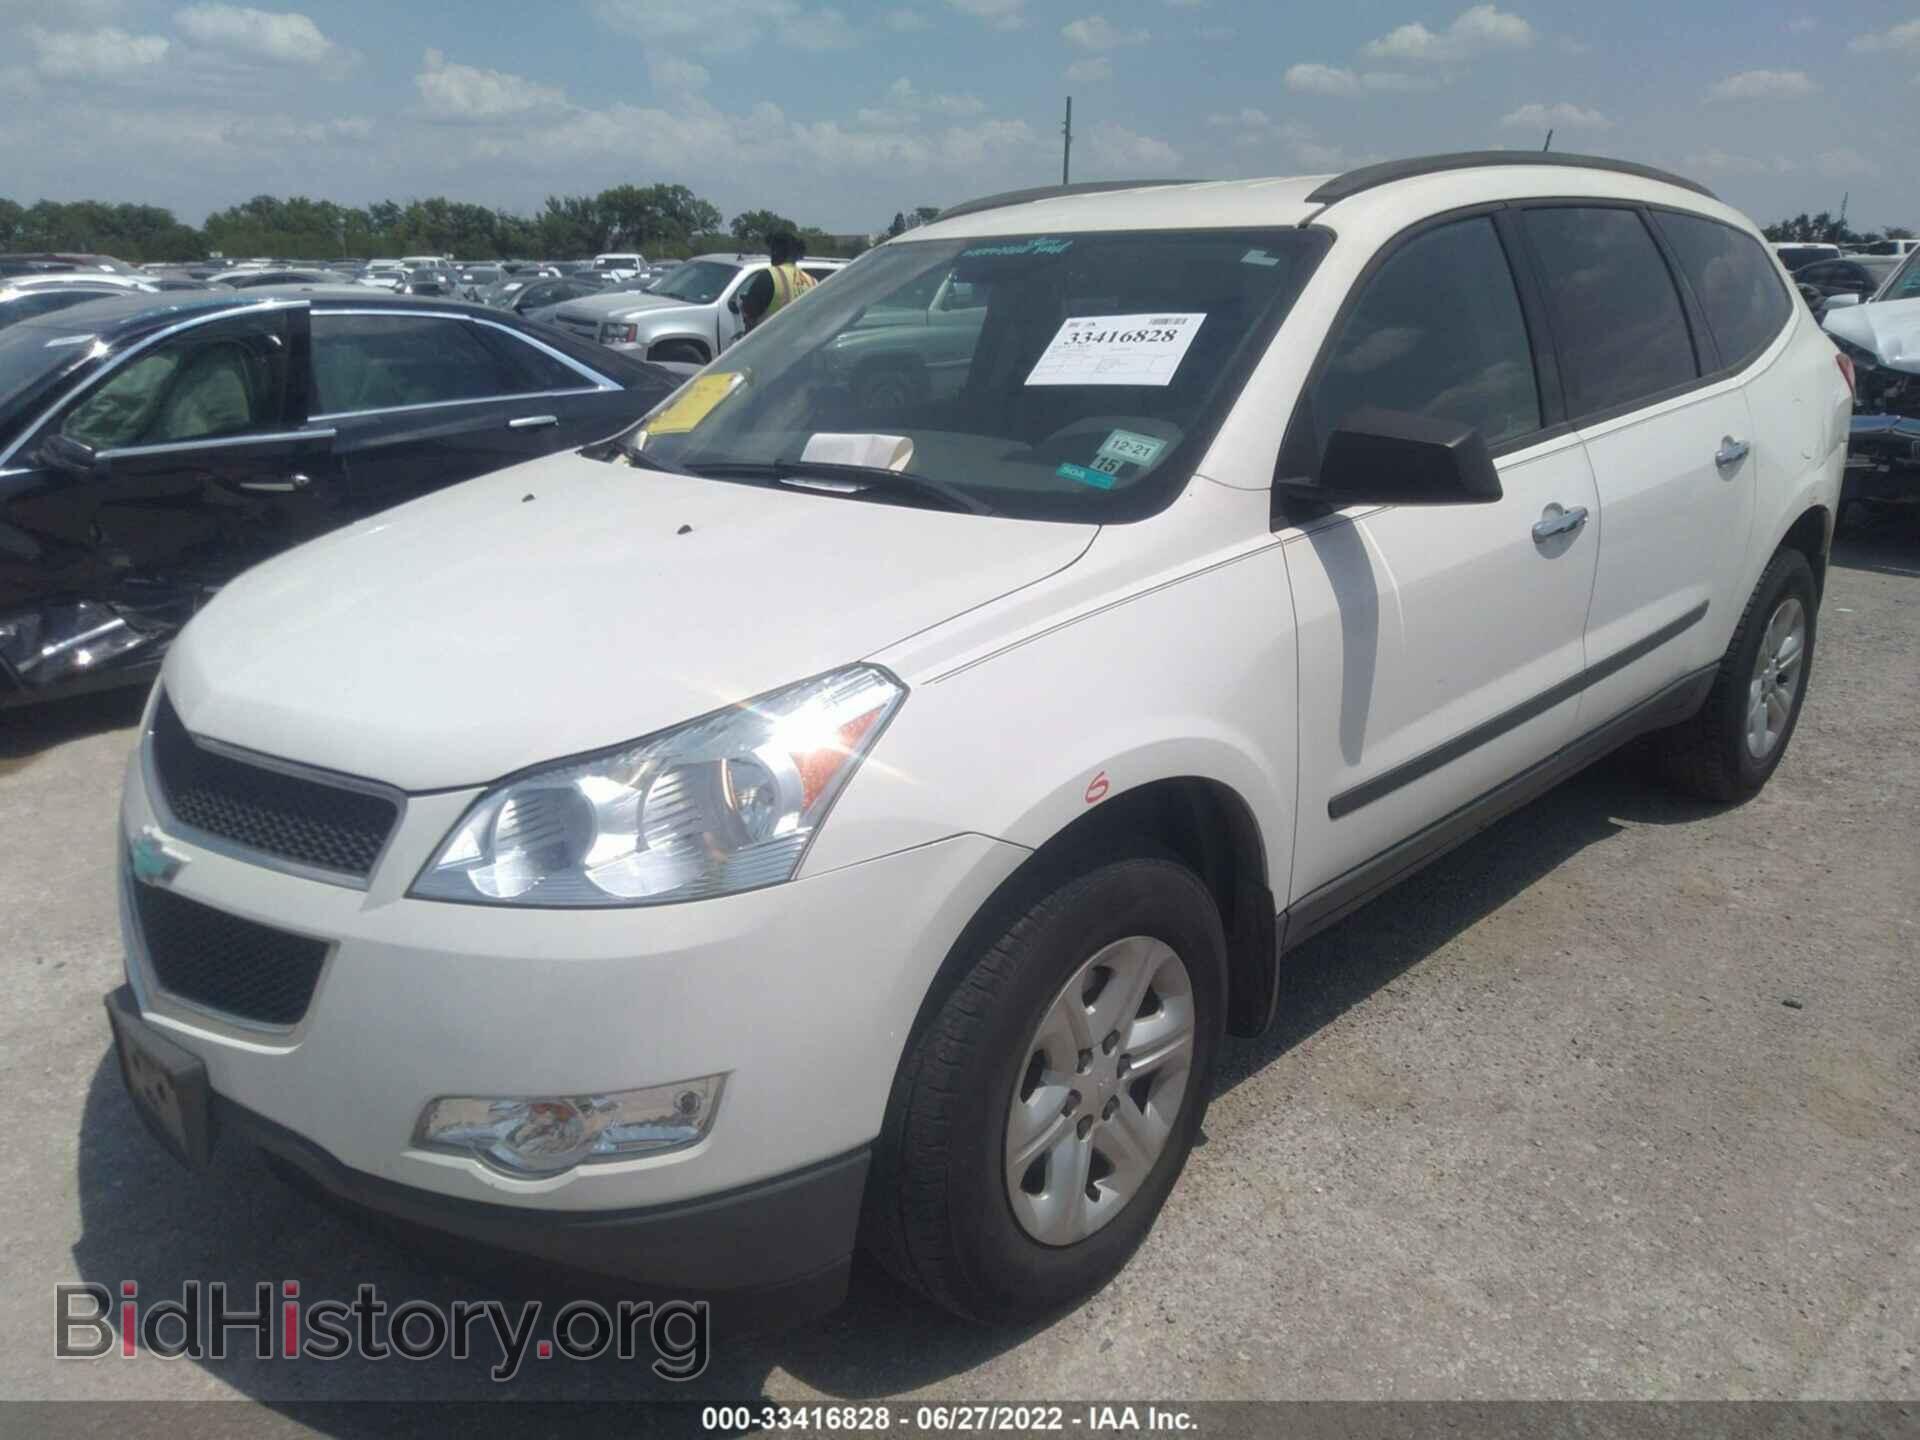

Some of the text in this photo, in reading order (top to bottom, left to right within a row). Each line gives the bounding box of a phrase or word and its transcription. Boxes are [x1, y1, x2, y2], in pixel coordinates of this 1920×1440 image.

[1064, 328, 1178, 345] 33416828
[1097, 457, 1117, 473] 15
[1084, 770, 1109, 804] 6
